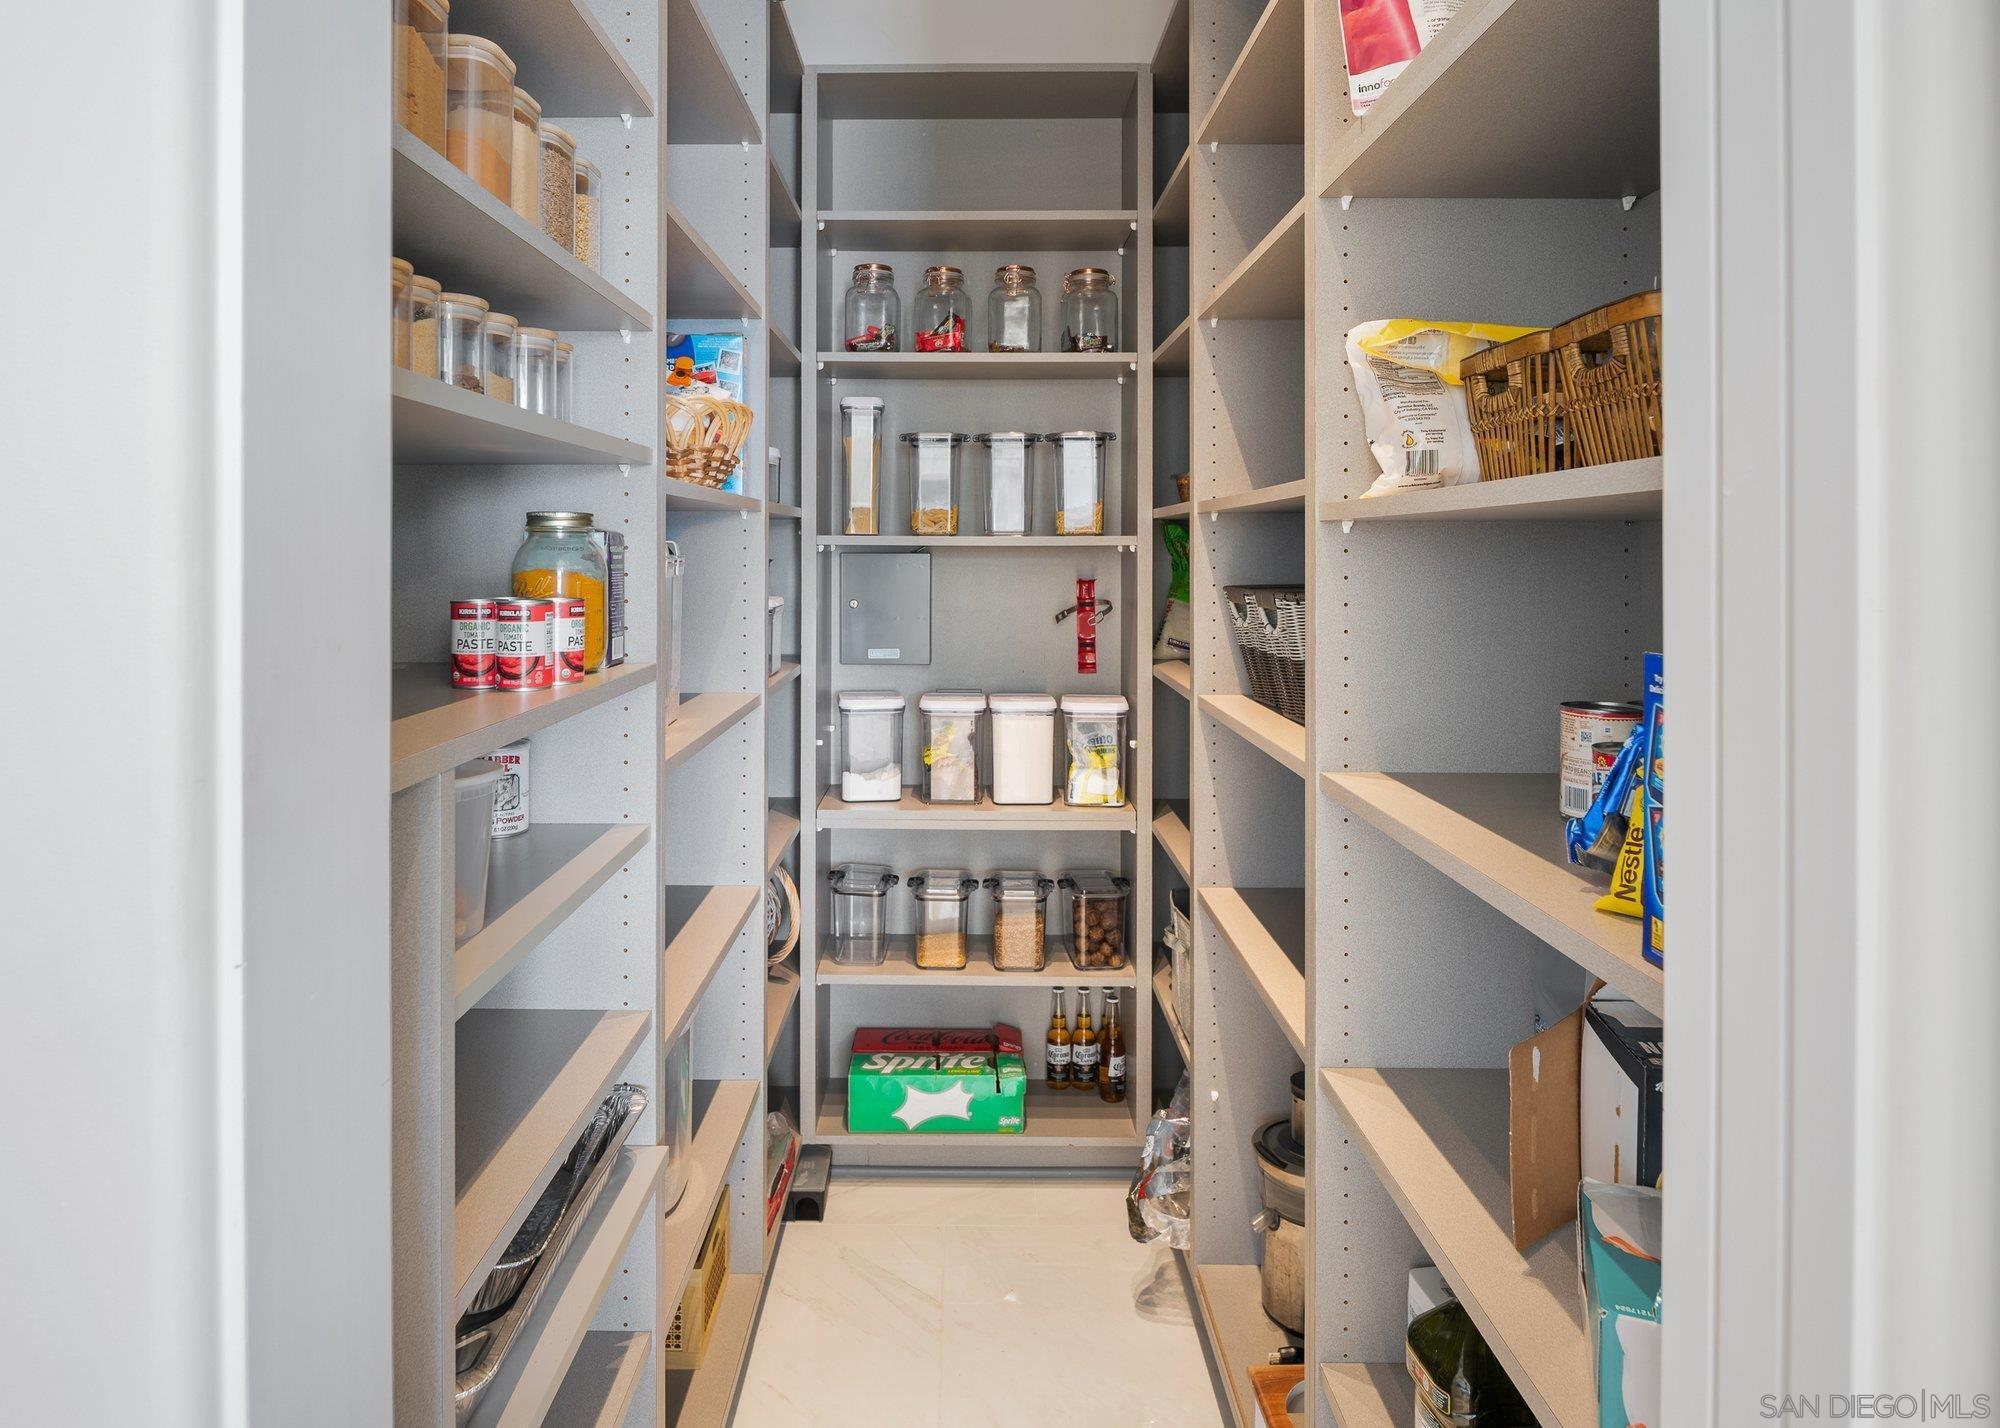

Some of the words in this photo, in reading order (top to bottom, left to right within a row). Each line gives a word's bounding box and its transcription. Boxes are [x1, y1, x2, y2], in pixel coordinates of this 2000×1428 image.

[459, 621, 490, 631] ORGANIC
[499, 623, 529, 633] ORGANC
[571, 619, 584, 628] ORGA
[457, 638, 494, 650] PASTE
[498, 641, 532, 651] PASTE
[568, 636, 584, 646] PAS
[487, 755, 521, 764] ABBER
[862, 1053, 986, 1074] Sprite
[999, 1116, 1022, 1126] Sprite
